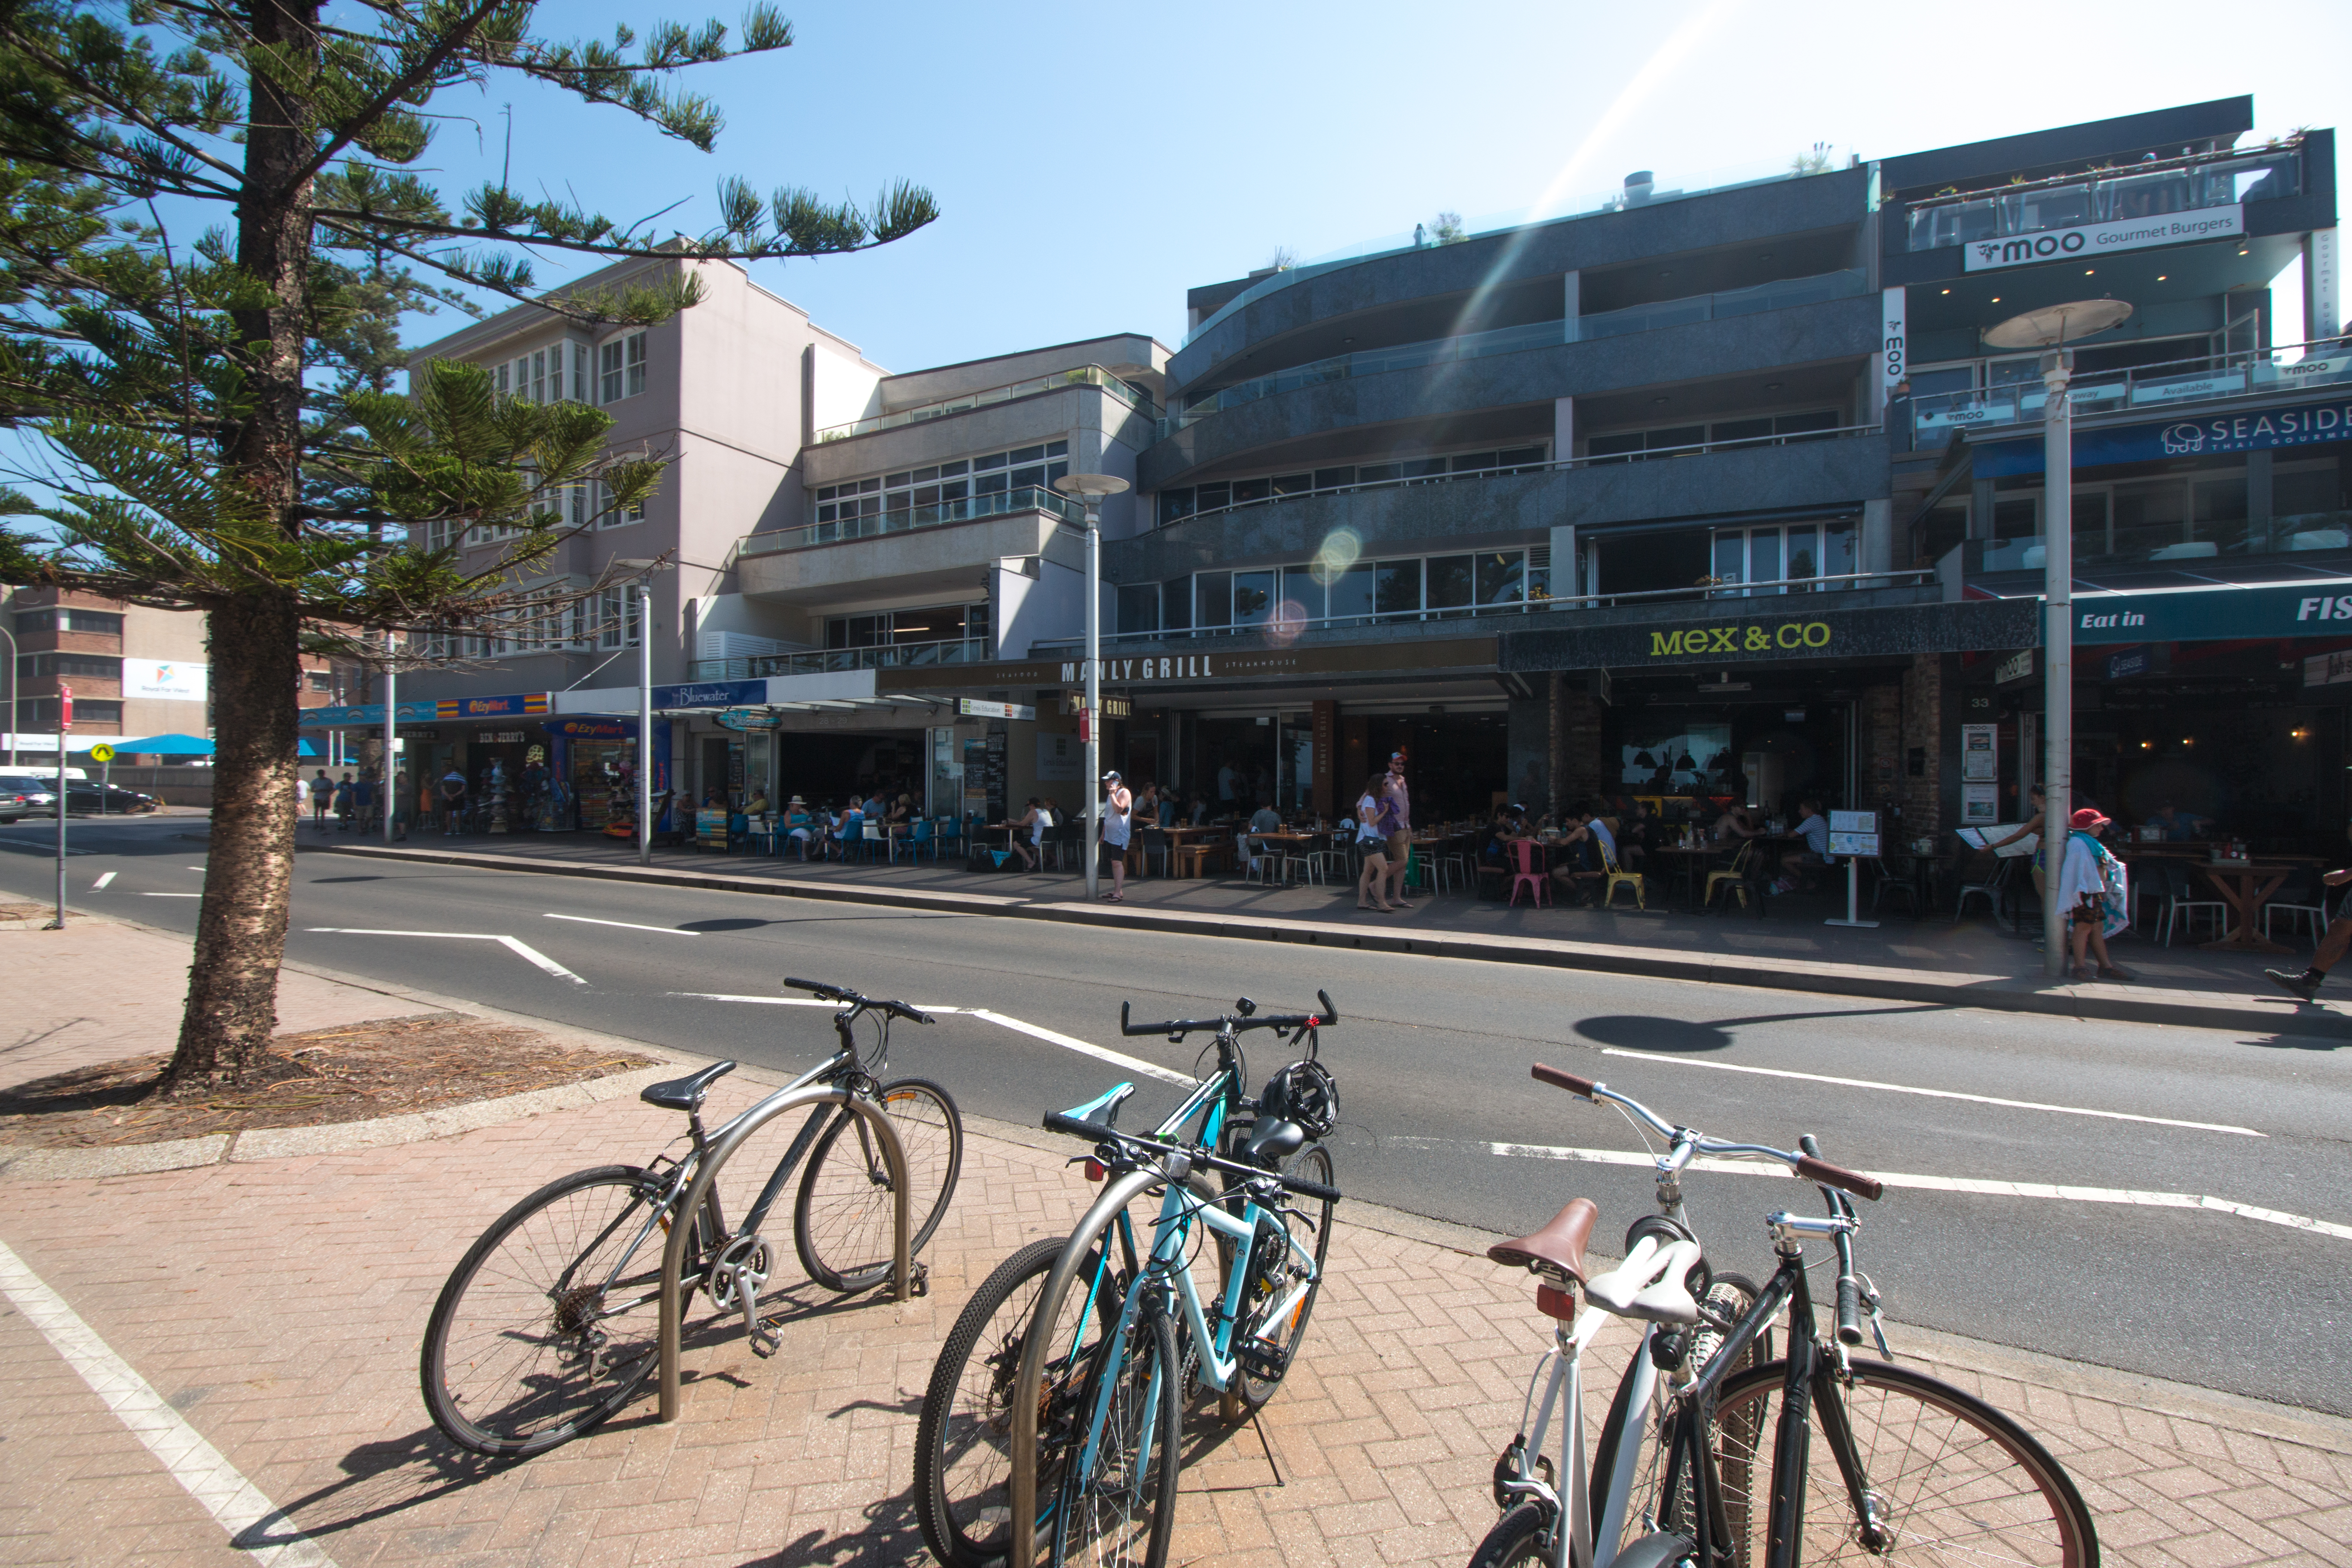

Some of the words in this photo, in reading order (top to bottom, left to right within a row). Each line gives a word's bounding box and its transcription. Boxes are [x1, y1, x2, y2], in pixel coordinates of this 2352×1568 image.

[2002, 232, 2086, 262] moo
[2096, 226, 2166, 245] Gourmet
[2171, 217, 2233, 236] Burgers
[1886, 337, 1903, 376] moo
[2293, 362, 2330, 375] moo
[2072, 390, 2099, 400] away
[2162, 382, 2213, 396] Available
[1954, 411, 1984, 421] moo
[2211, 441, 2254, 450] THAI
[2297, 595, 2352, 621] FIS
[2080, 614, 2119, 628] Eat
[2122, 611, 2145, 626] in
[1744, 626, 1771, 651] &
[1142, 655, 1212, 680] GRILL
[1225, 659, 1297, 668] STEAKHOUSE
[680, 687, 730, 706] Bluewater
[1971, 698, 1989, 707] 33
[1107, 700, 1131, 716] GRILL
[578, 723, 623, 735] EzyMart
[479, 732, 493, 743] BEN
[498, 731, 525, 743] JERRY'S
